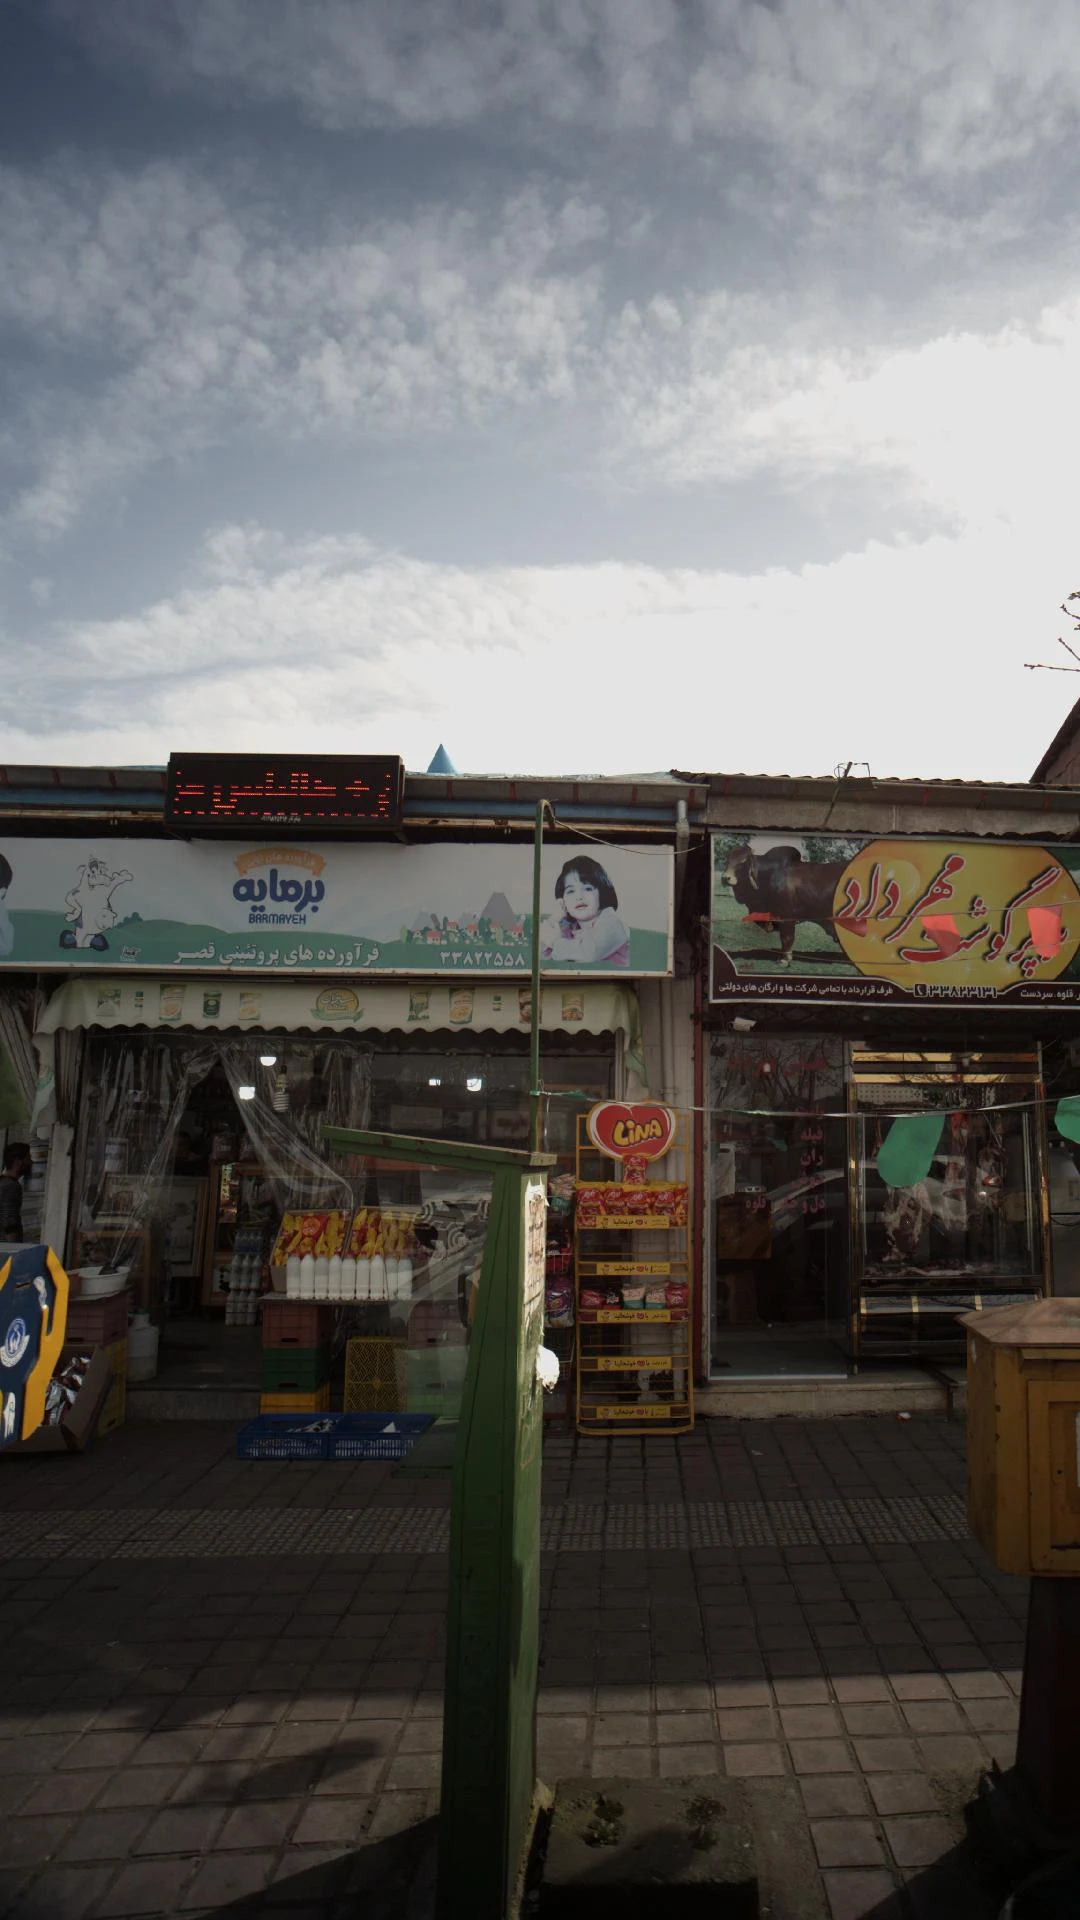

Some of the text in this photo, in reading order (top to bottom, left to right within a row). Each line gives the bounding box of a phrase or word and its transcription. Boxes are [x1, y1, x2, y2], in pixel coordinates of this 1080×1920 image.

[233, 868, 325, 913] برمایه
[248, 913, 306, 925] BARMAYEH
[173, 942, 216, 964] قصر
[219, 944, 279, 967] پروتئینی
[284, 945, 313, 965] های
[439, 951, 525, 967] ۳۳۸۲۲۵۵۸
[718, 982, 741, 992] دولتی
[742, 982, 757, 993] های
[758, 982, 778, 992] ارگان
[785, 983, 793, 992] ها
[794, 983, 818, 994] شرکت
[819, 982, 840, 995] تمامی
[841, 984, 847, 994] با
[847, 984, 876, 996] قرارداد
[1020, 989, 1053, 1000] سردست
[1056, 988, 1074, 1001] قلوه
